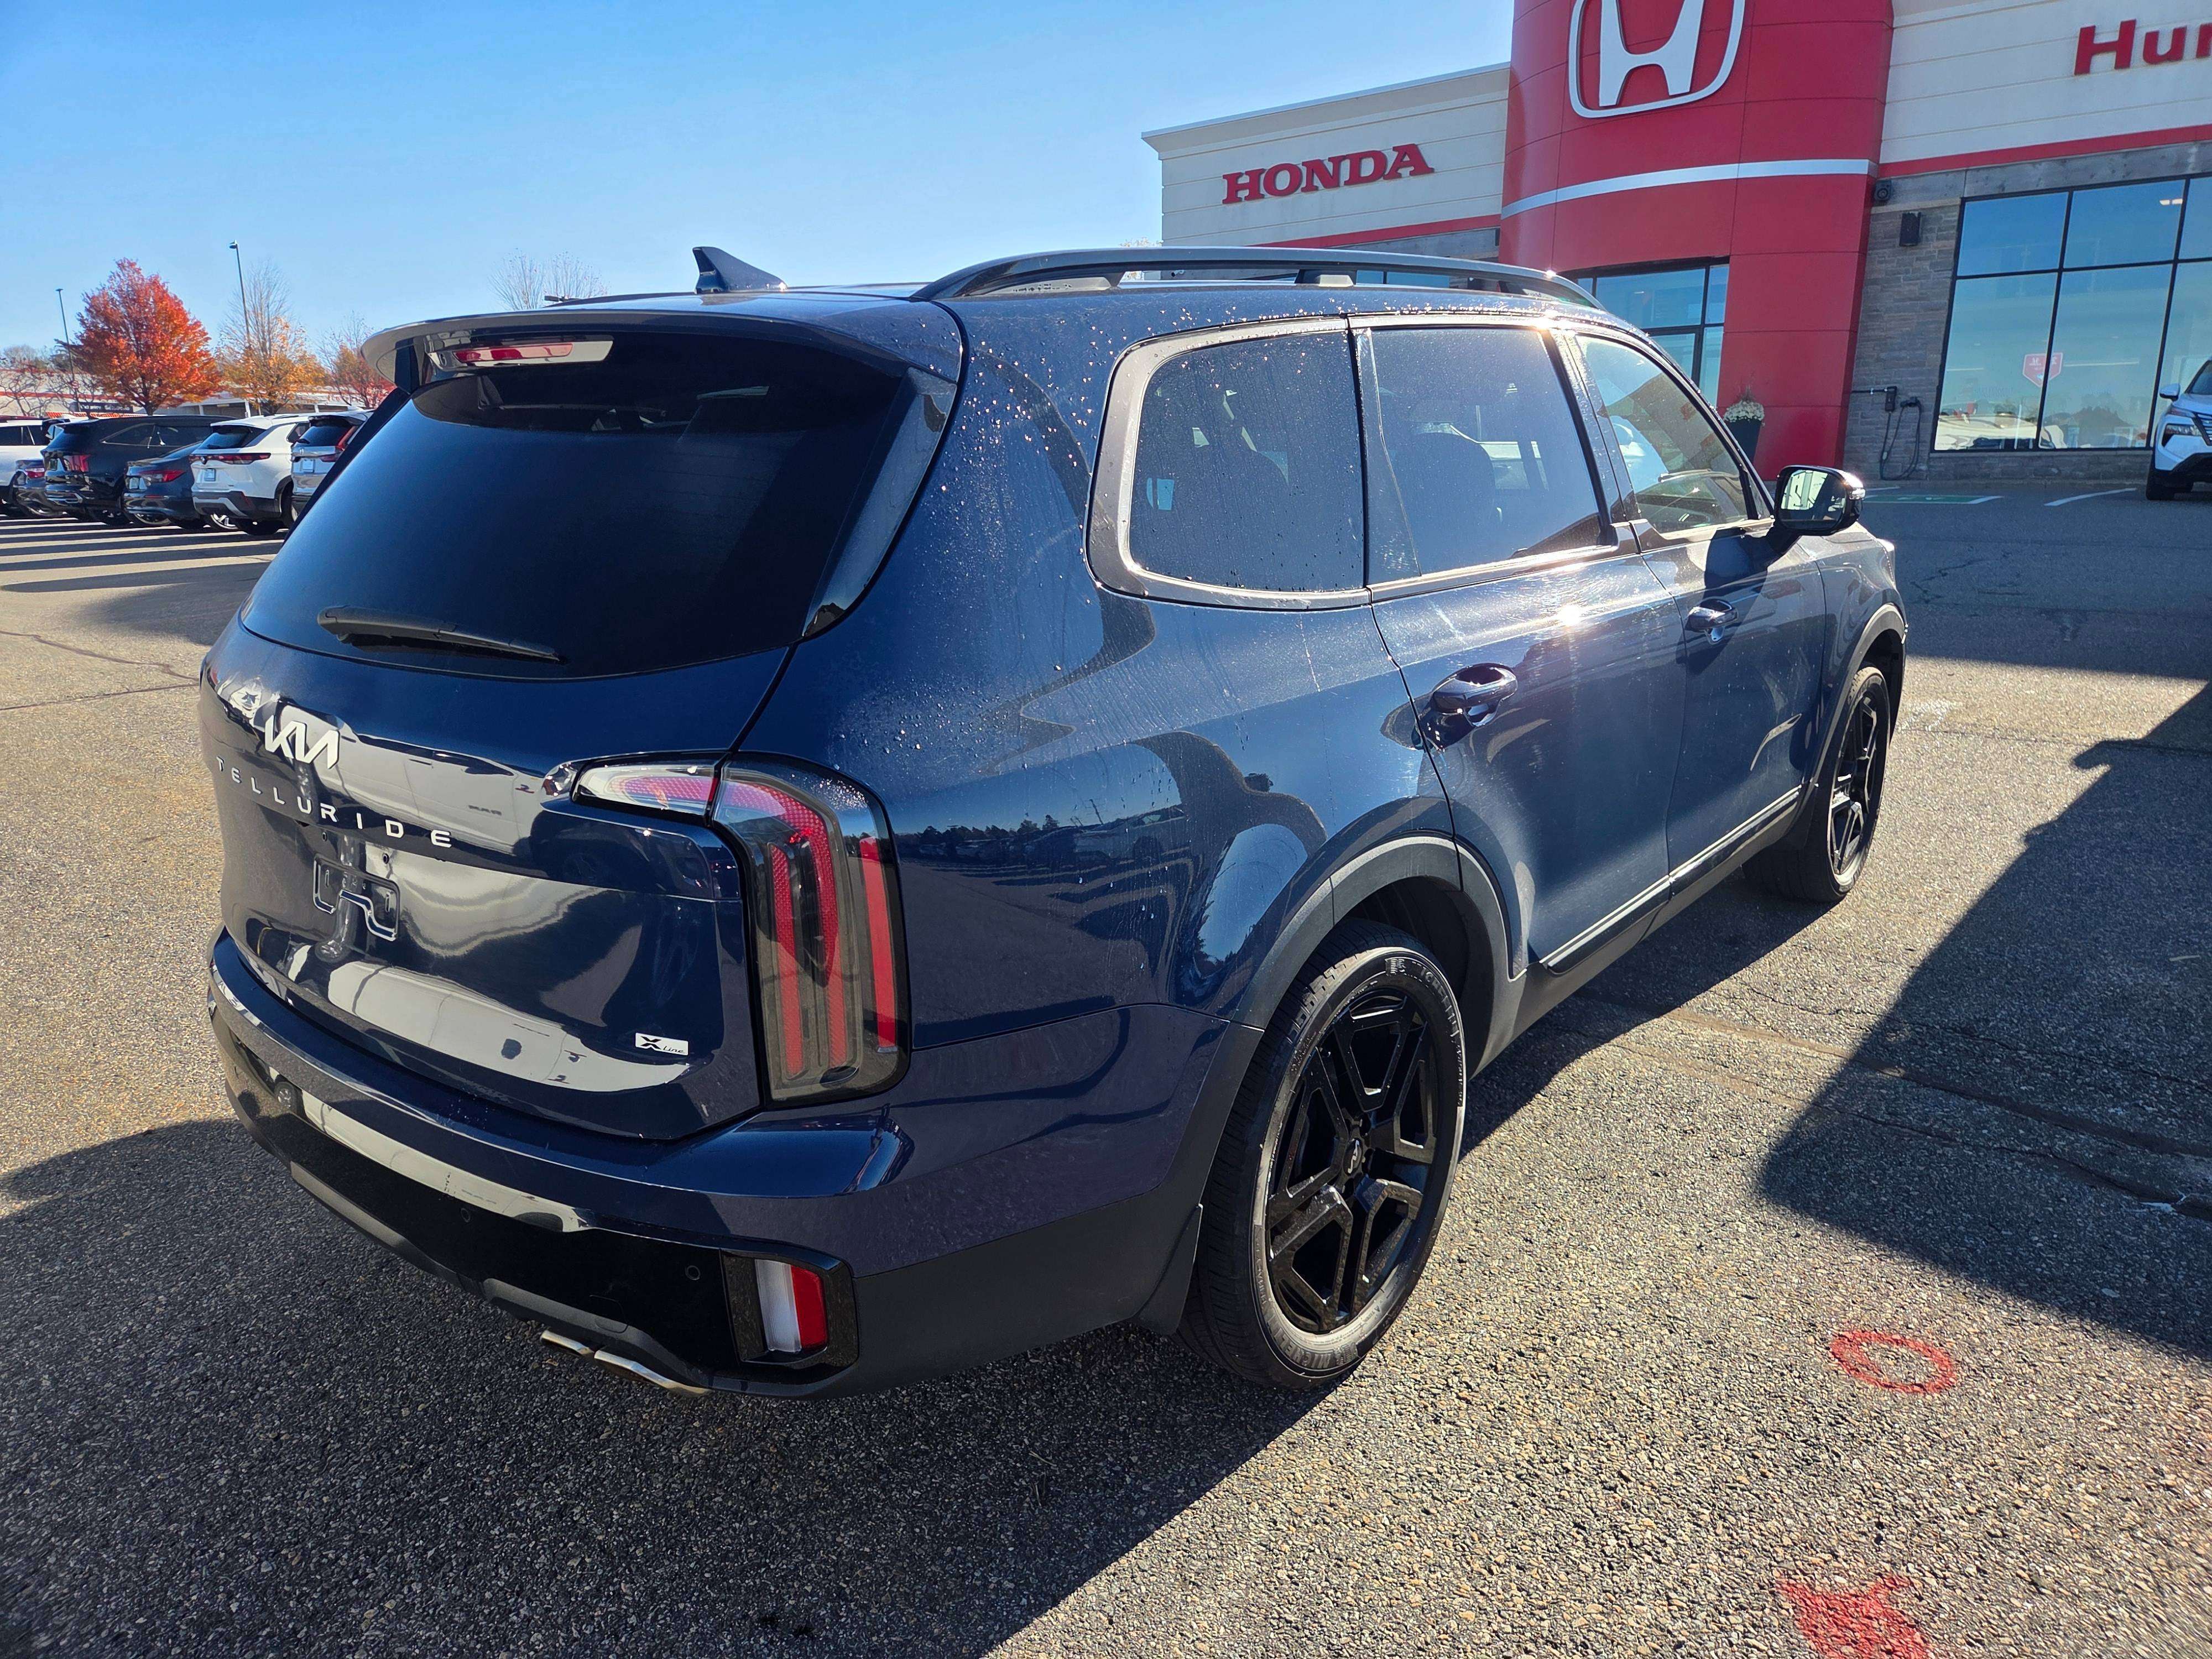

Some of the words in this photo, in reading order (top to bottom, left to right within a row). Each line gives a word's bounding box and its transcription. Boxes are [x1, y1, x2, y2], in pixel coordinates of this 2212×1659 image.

[1222, 143, 1434, 205] HONDA
[264, 714, 340, 769] KIA
[216, 755, 452, 848] TELLURIDE
[1411, 961, 1460, 1037] ICHELIN
